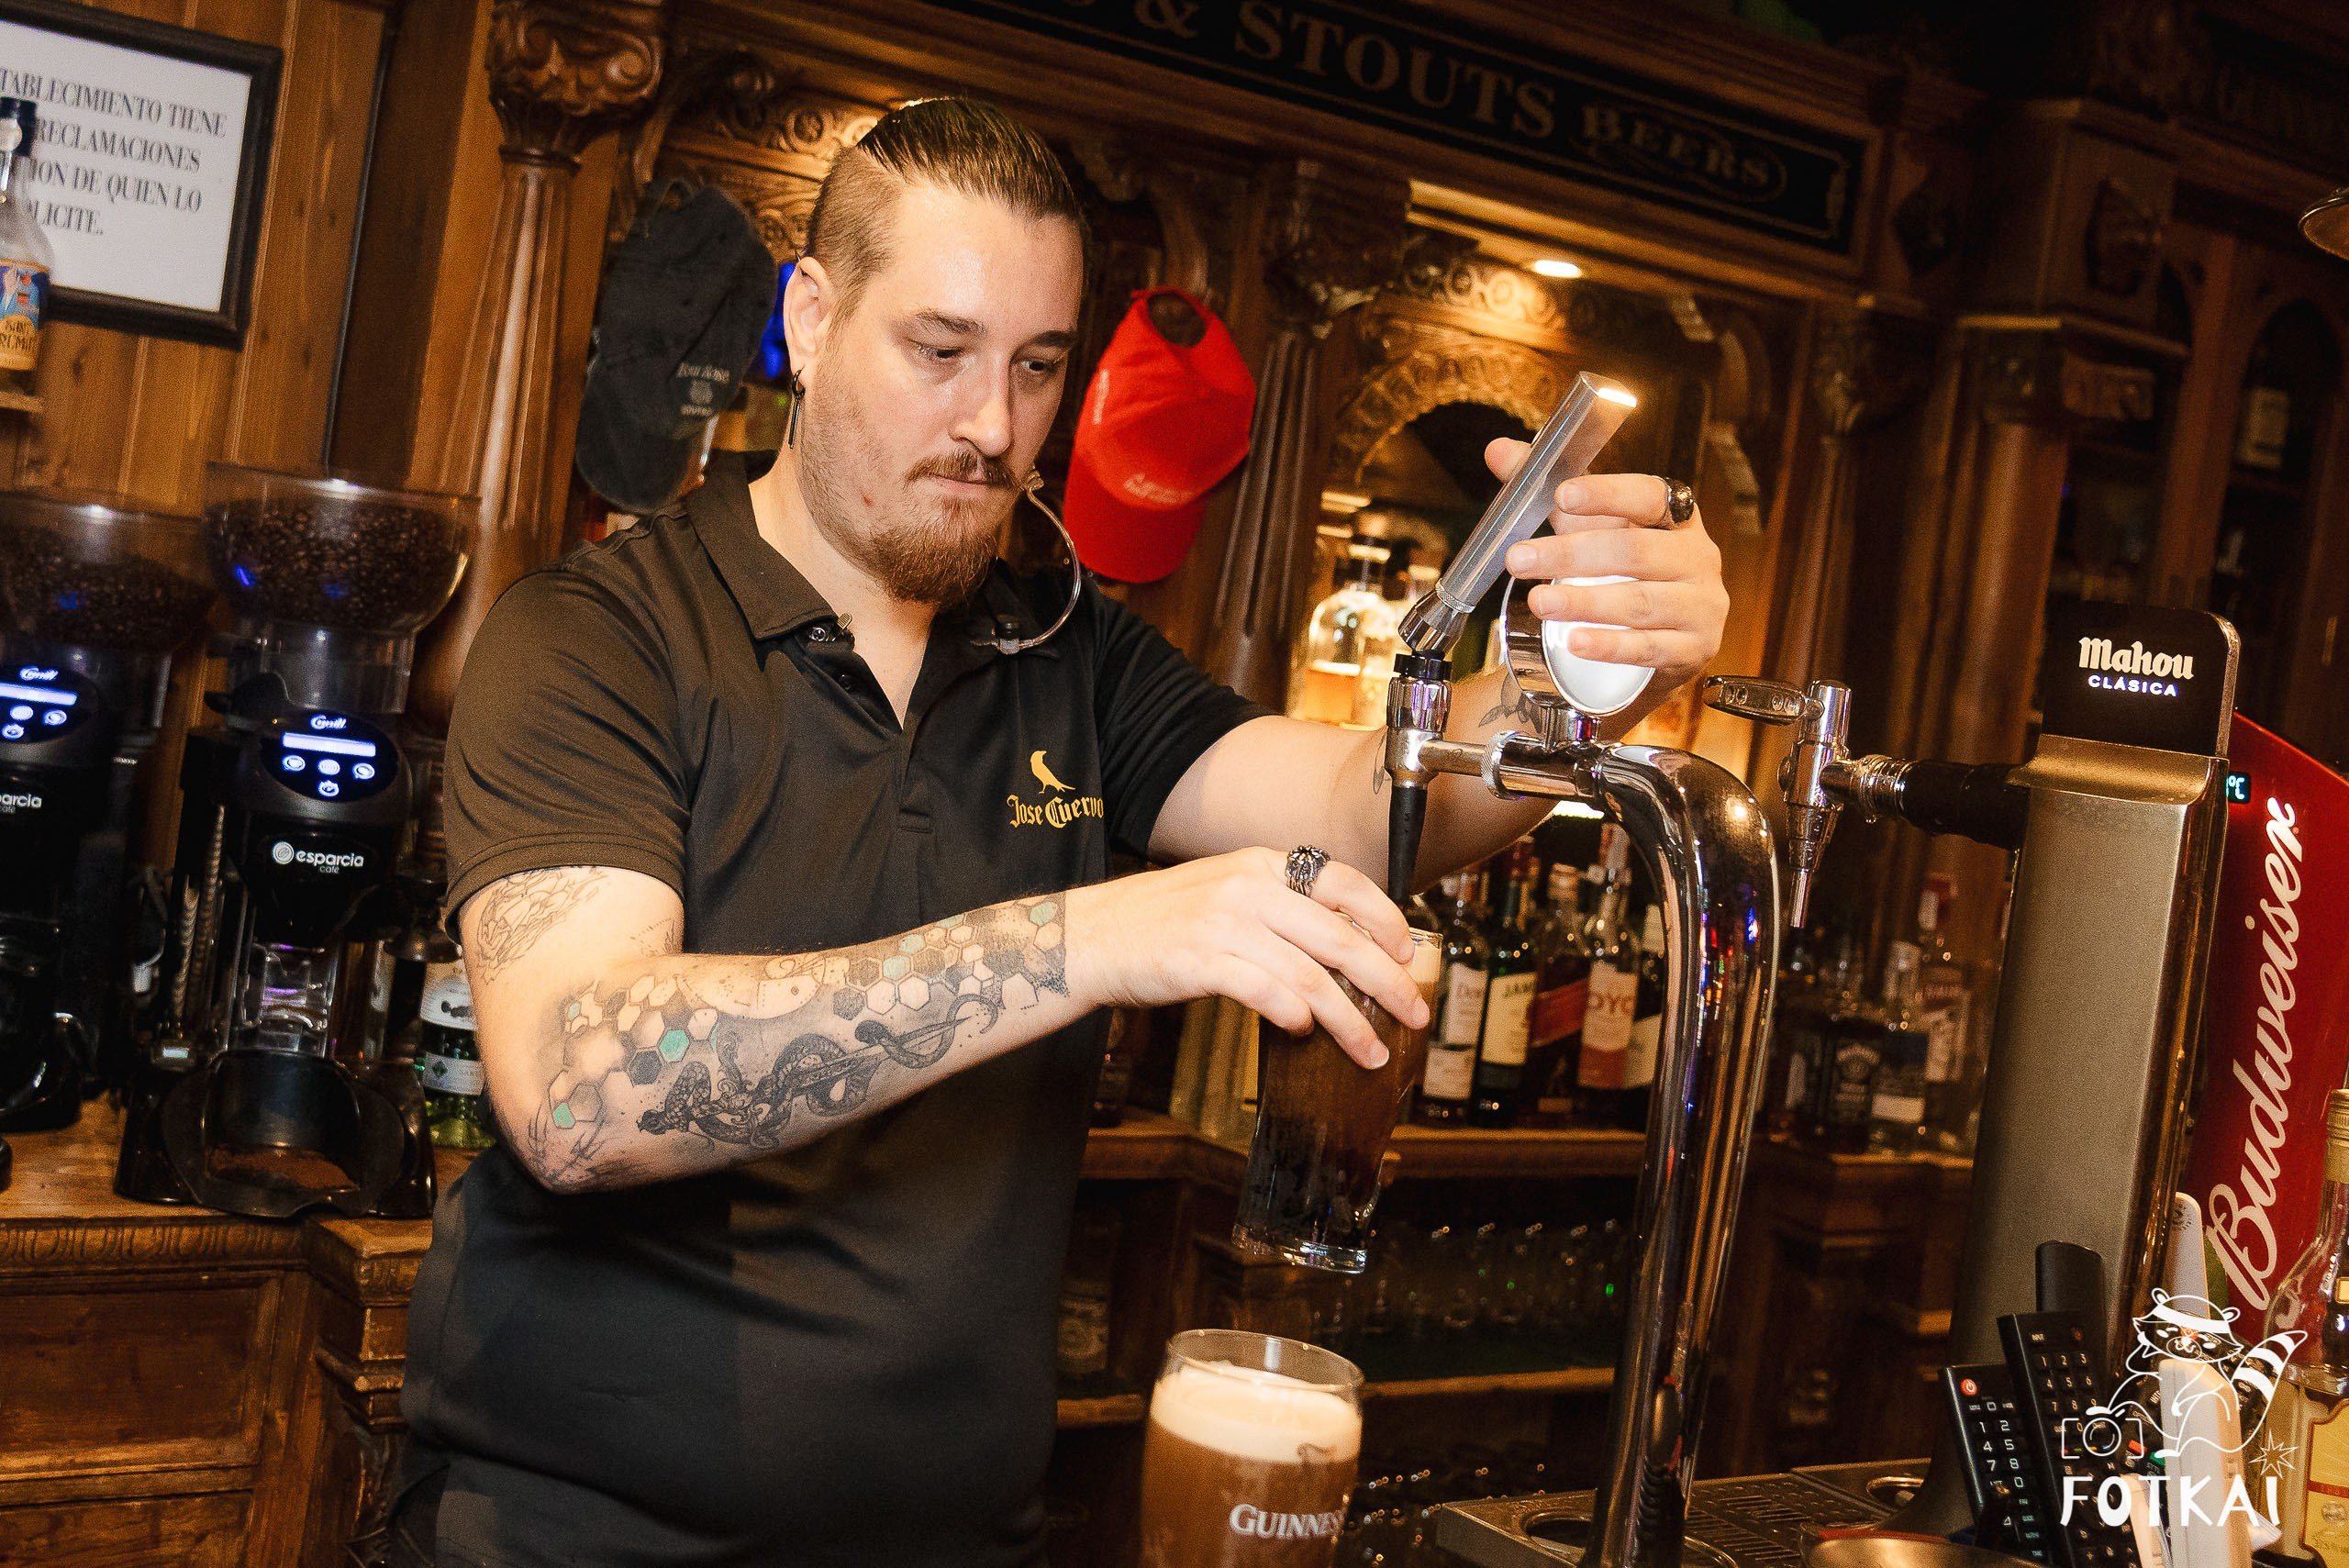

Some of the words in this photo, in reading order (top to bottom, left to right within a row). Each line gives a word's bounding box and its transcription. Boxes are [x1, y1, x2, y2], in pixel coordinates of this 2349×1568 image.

[1233, 0, 1557, 139] STOUTS
[1580, 99, 1771, 189] BEERS
[168, 103, 228, 139] TIENE
[37, 116, 201, 172] RECLAMACIONES
[72, 165, 103, 195] DE
[106, 172, 169, 206] QUIEN
[173, 185, 203, 213] LO
[2078, 636, 2194, 680] Mahou
[0, 792, 43, 808] arcia
[1007, 794, 1044, 828] Jose
[1044, 795, 1104, 828] Cuervo
[295, 850, 364, 867] esparcia
[2205, 795, 2304, 1311] Budweiser
[2041, 1355, 2048, 1367] 1
[2060, 1354, 2067, 1365] 2
[2079, 1353, 2087, 1364] 3
[2046, 1379, 2054, 1390] 4
[2065, 1377, 2073, 1388] 5
[2086, 1375, 2093, 1386] 6
[2052, 1401, 2058, 1412] 7
[2071, 1399, 2078, 1411] 8
[1978, 1421, 1987, 1434] 1
[1998, 1419, 2010, 1432] 2
[1982, 1440, 1993, 1452] 4
[2004, 1439, 2015, 1451] 5
[1986, 1459, 1997, 1472] 7
[2009, 1458, 2020, 1469] 8
[2013, 1476, 2024, 1488] 0
